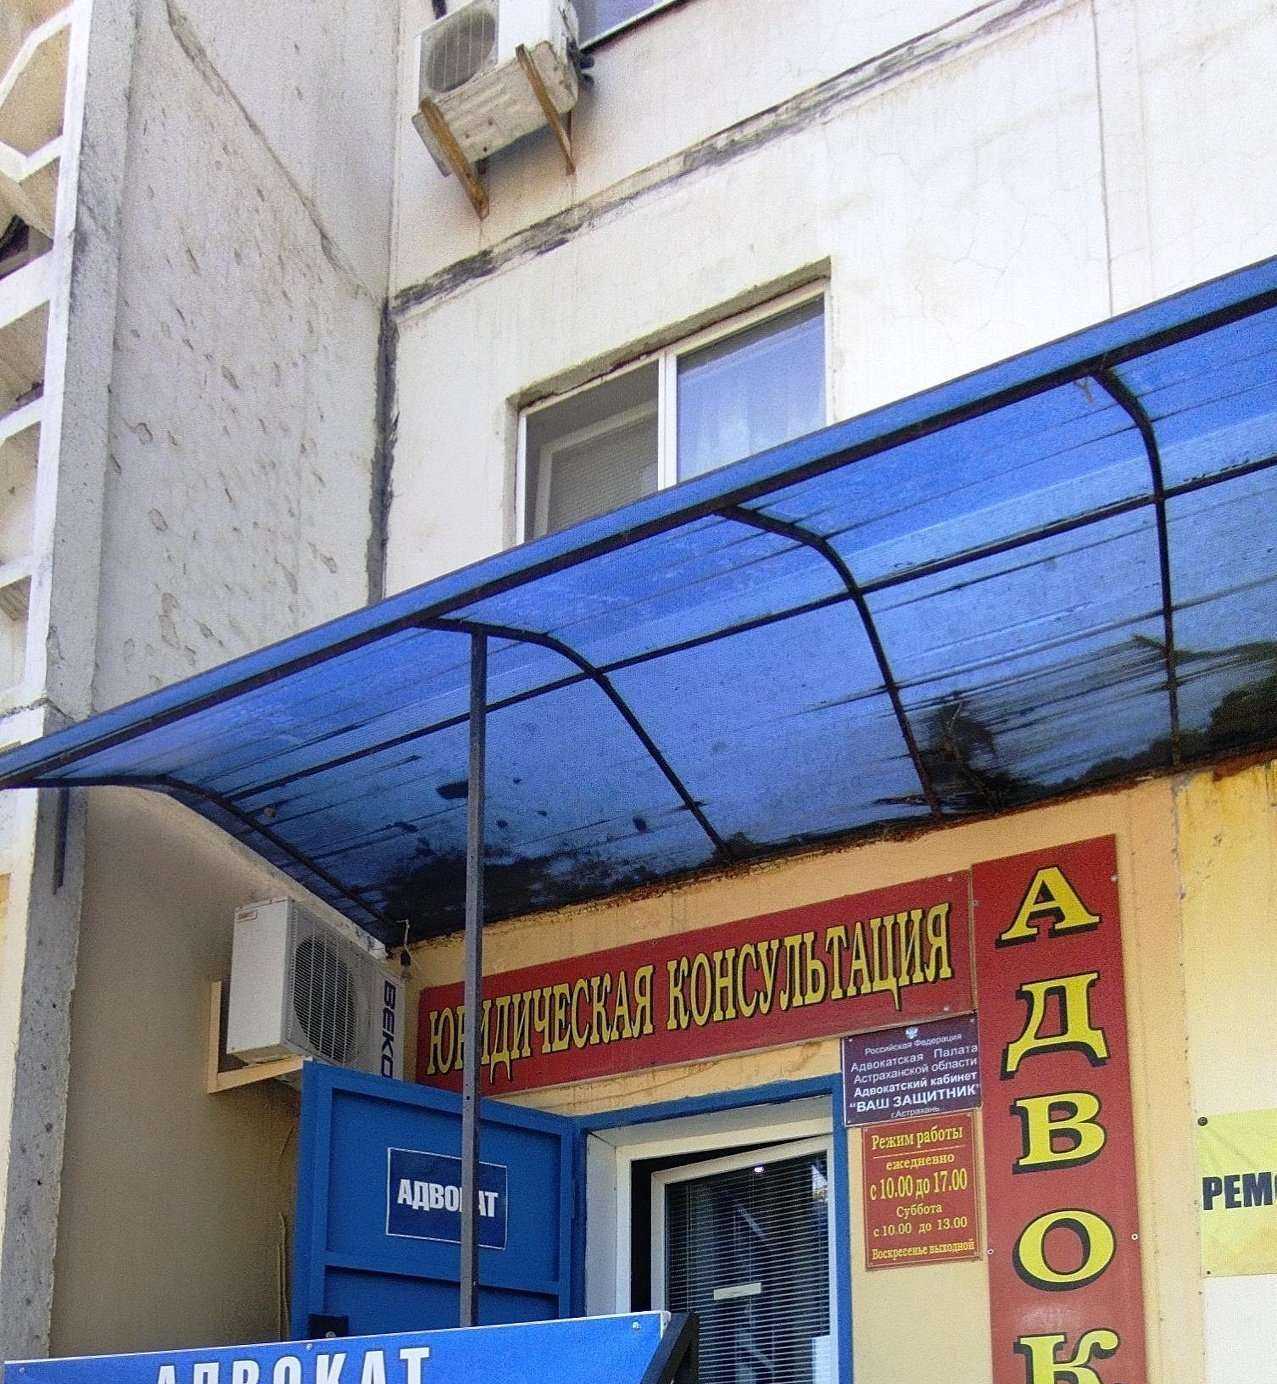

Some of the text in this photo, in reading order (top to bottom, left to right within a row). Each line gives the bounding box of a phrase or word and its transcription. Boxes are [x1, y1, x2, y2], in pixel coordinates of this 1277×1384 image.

[666, 901, 953, 1031] КОНСУЛЬТАЦИЯ
[864, 1033, 963, 1056] Российская Федерация
[850, 1043, 979, 1074] Адвокатская Палата
[853, 1057, 978, 1085] Астраханской области
[853, 1071, 978, 1099] Адвокатский кабинет
[871, 1126, 963, 1150] Режим работы
[886, 1153, 955, 1171] ежедневно
[880, 1175, 913, 1200] 10.00
[915, 1178, 931, 1200] до
[933, 1168, 967, 1193] 17.00
[1202, 1171, 1277, 1210] РЕМ
[896, 1203, 943, 1219] Суббота
[918, 1224, 932, 1234] до
[938, 1216, 967, 1231] 13.00
[872, 1239, 975, 1261] Воскресенье выходной
